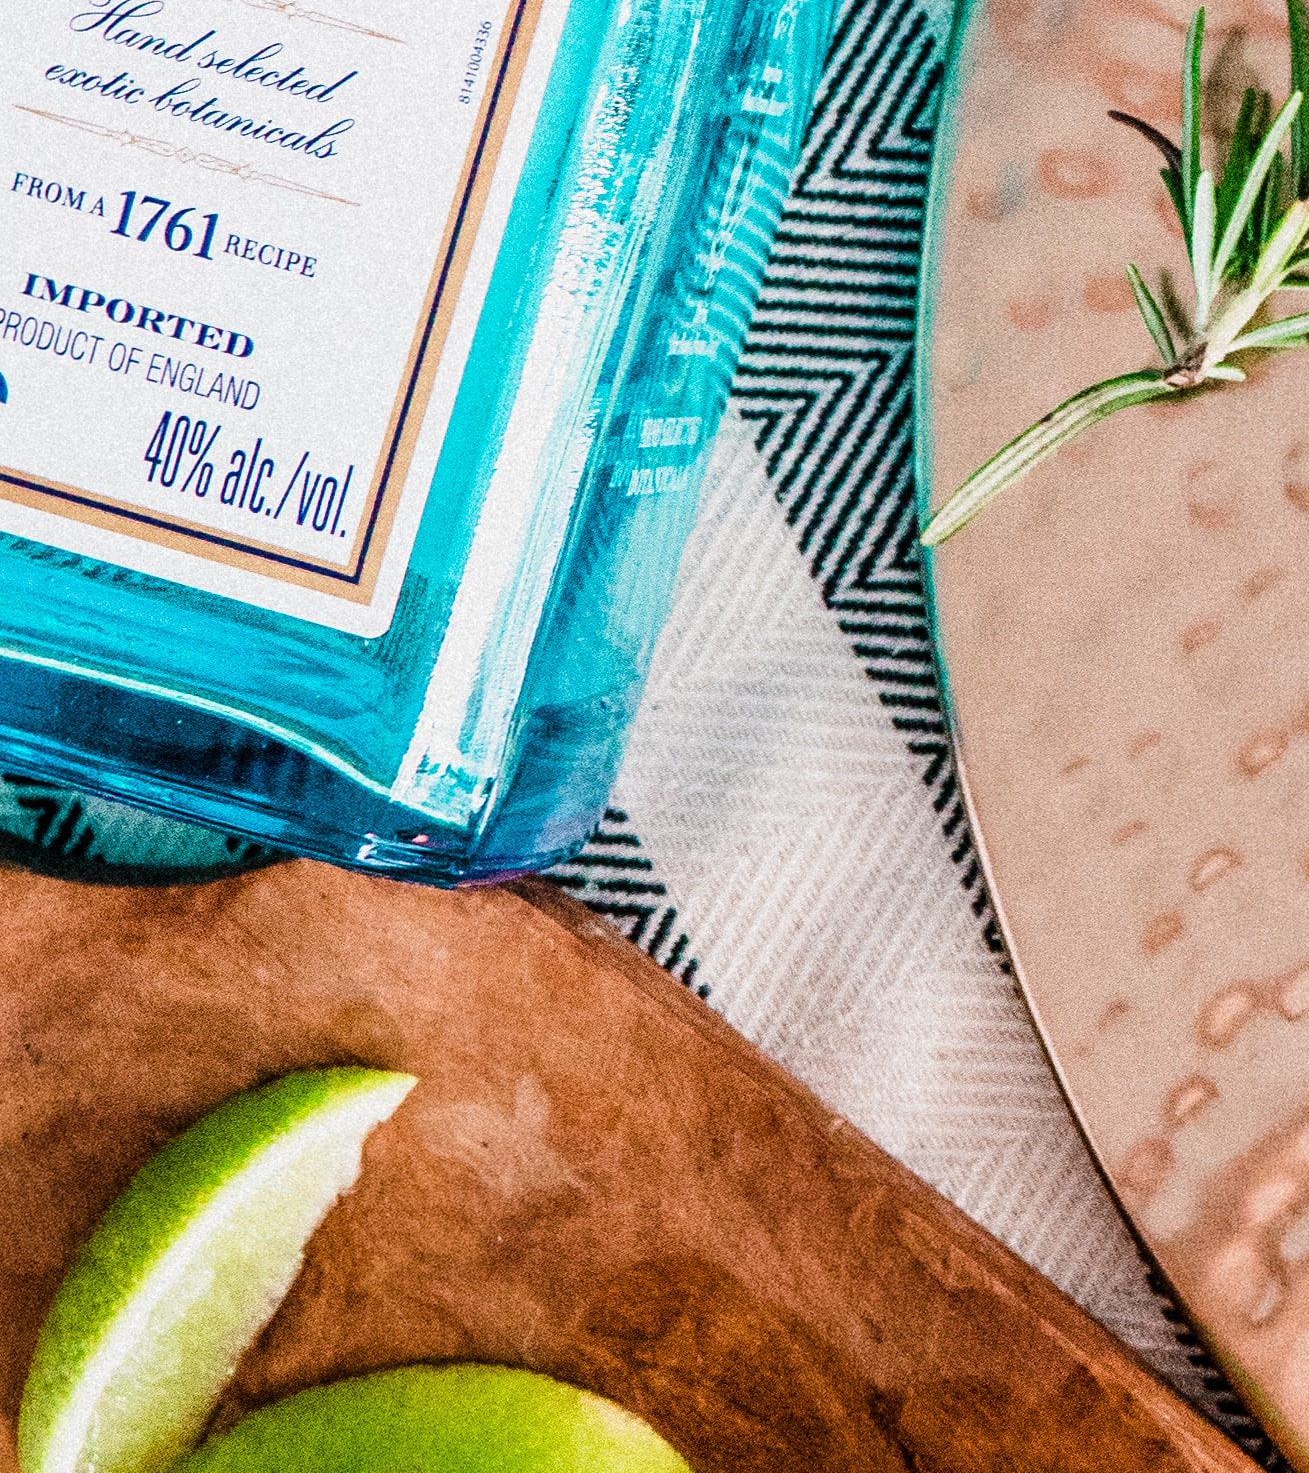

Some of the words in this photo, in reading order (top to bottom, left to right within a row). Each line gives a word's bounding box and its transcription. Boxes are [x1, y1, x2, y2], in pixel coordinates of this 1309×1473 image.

[198, 42, 359, 104] selected
[459, 20, 493, 105] 8141004336
[45, 60, 144, 106] exotic
[149, 79, 356, 160] botanicals
[11, 172, 85, 211] FROM
[87, 196, 106, 216] A
[111, 189, 220, 261] 1761
[224, 233, 318, 279] RECIPE
[18, 272, 254, 358] IMPORTED
[108, 342, 143, 375] OF
[146, 353, 261, 411] ENGLAND
[144, 410, 222, 498] 40%
[221, 438, 355, 539] alc./vol.
